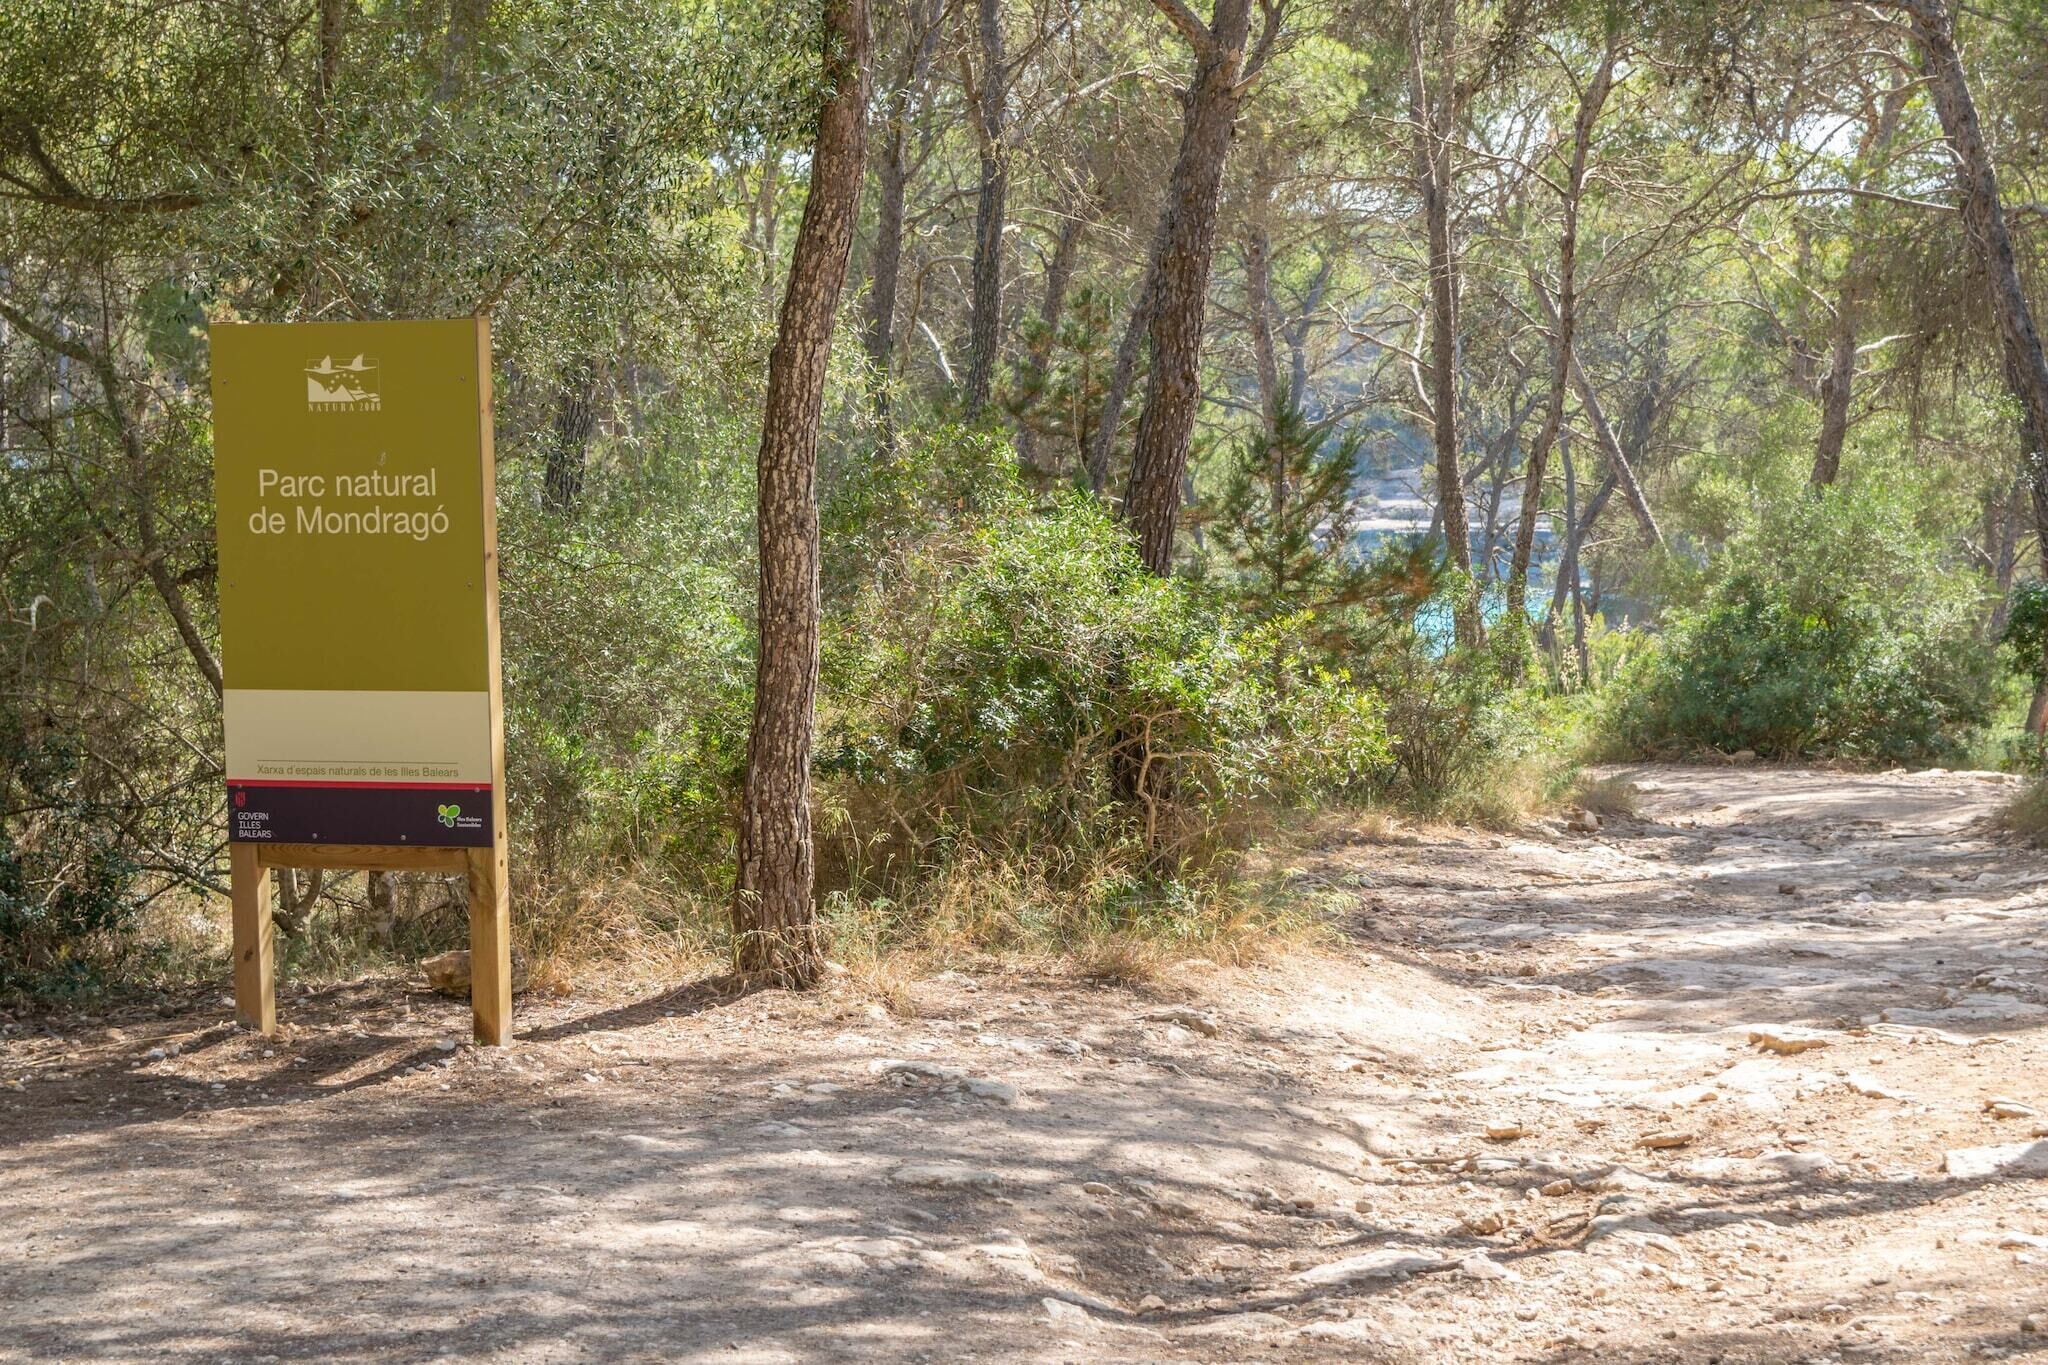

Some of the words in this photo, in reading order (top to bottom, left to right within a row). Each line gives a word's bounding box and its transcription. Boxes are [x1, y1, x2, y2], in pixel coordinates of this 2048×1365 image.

[308, 402, 355, 412] NATURA
[258, 468, 325, 497] Parc
[335, 467, 437, 497] natural
[249, 505, 286, 534] de
[296, 504, 449, 541] Mondragó
[257, 765, 284, 775] Xarxa
[328, 766, 368, 777] naturals
[369, 766, 382, 777] de
[384, 767, 398, 777] les
[400, 767, 420, 777] Illes
[422, 767, 459, 778] Balears
[238, 811, 269, 820] GOVERN
[239, 820, 261, 829] ILLES
[239, 829, 272, 838] BALEARS
